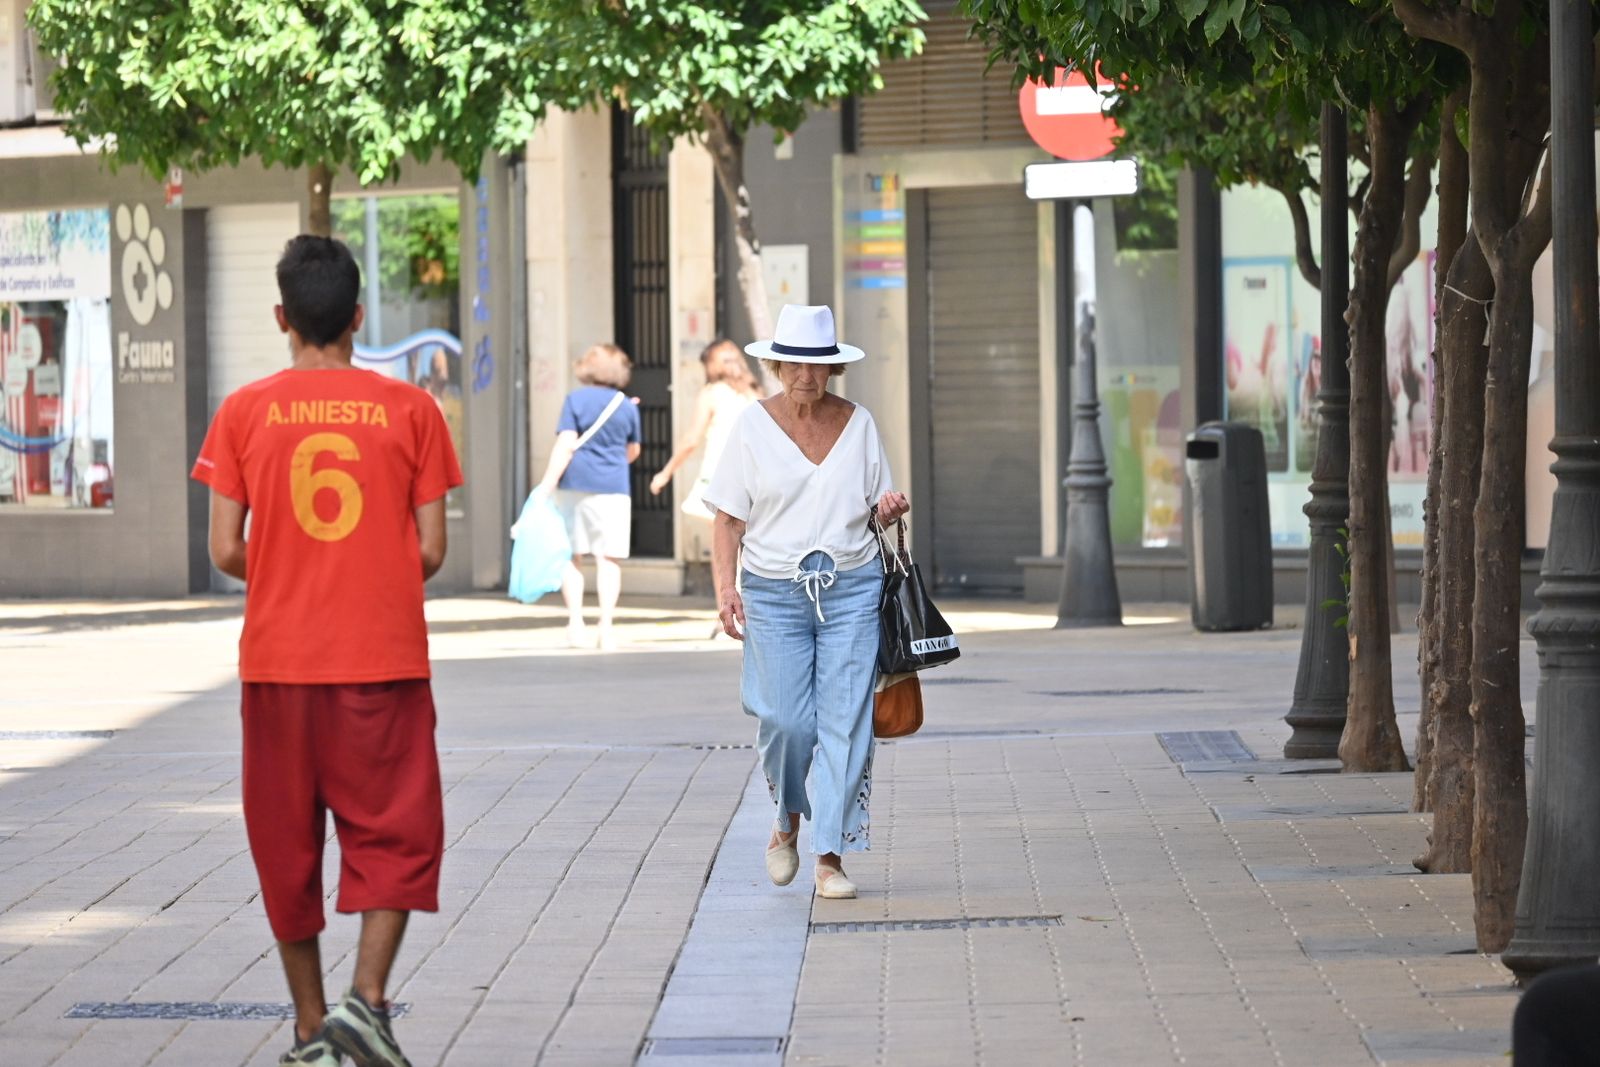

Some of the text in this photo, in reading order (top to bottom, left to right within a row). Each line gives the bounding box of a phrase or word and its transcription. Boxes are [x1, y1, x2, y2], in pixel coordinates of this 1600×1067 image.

[118, 331, 174, 368] Fauna
[264, 400, 388, 428] A.INIESTA
[290, 432, 363, 542] 6
[914, 638, 949, 652] MANGO
